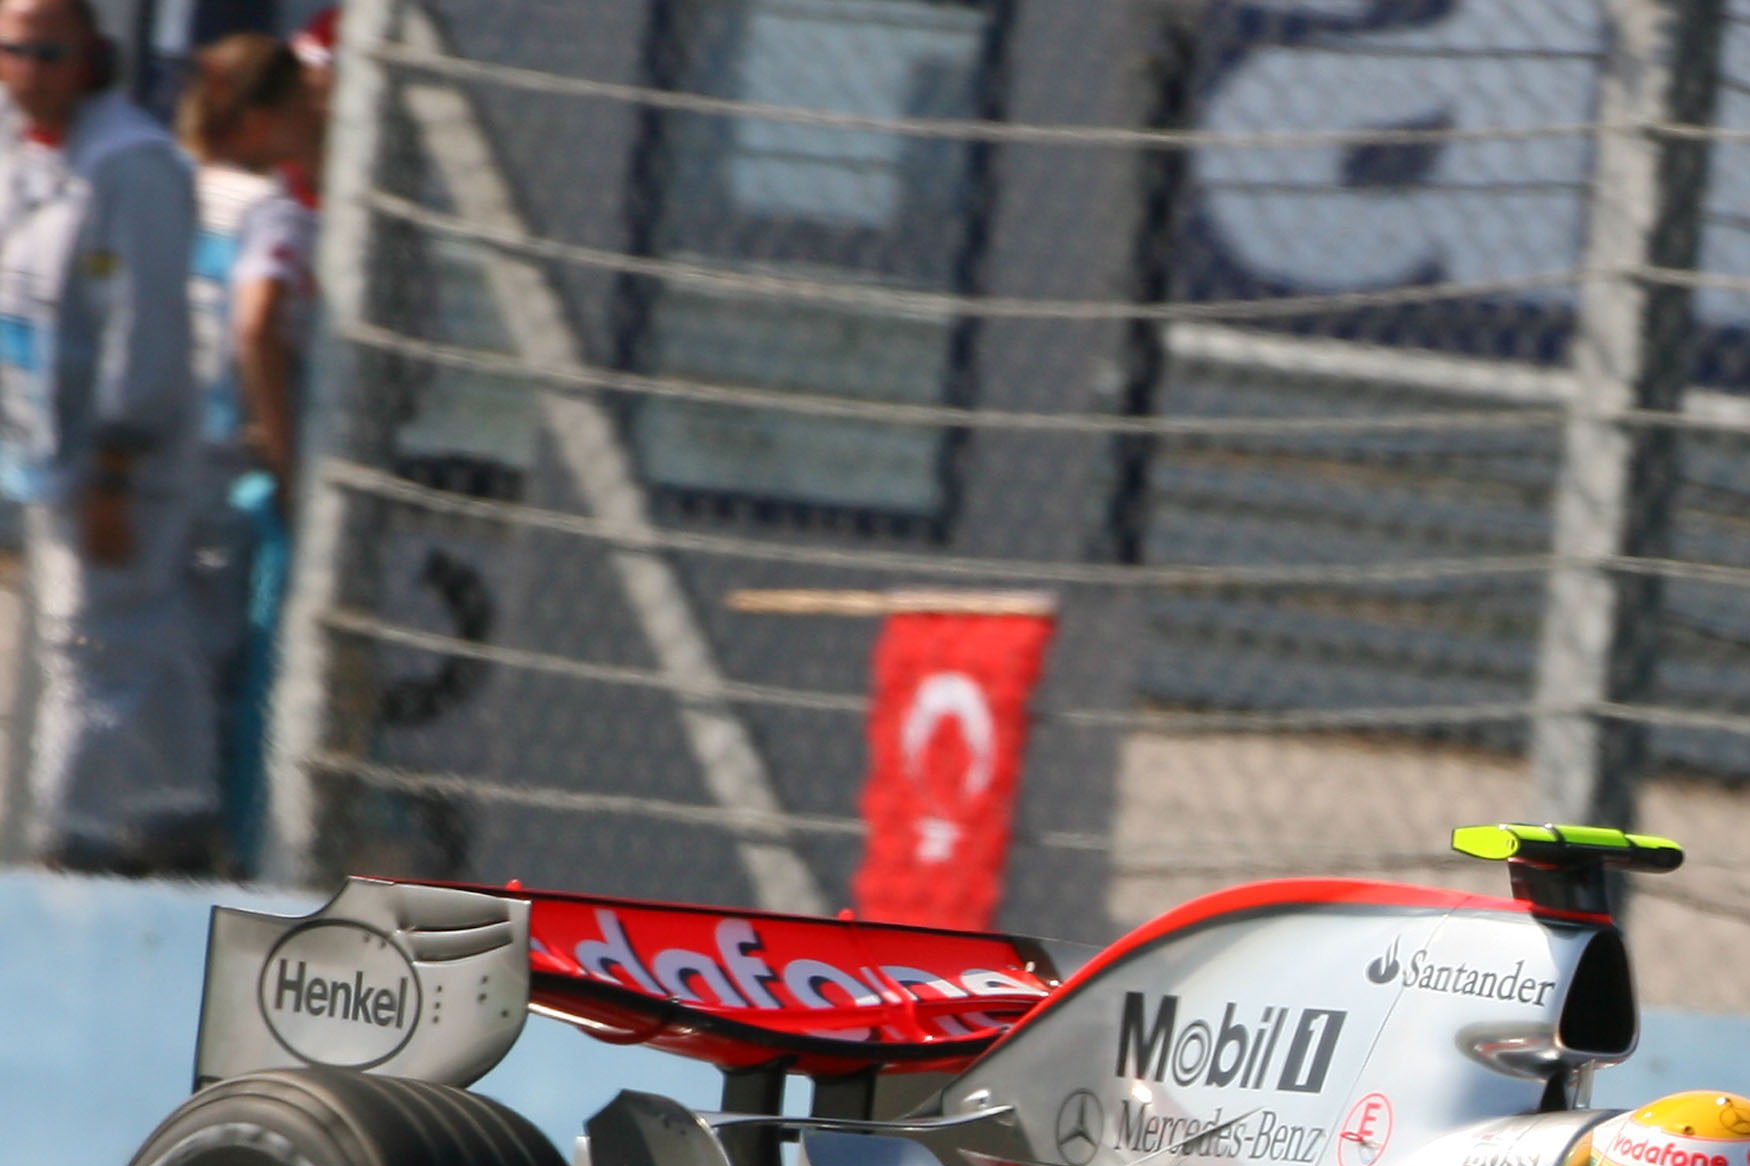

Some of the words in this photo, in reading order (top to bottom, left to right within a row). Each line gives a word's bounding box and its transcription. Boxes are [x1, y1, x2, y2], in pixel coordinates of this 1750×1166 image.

[274, 958, 408, 1029] Henkel
[1403, 948, 1555, 1009] Santander
[1115, 991, 1287, 1090] Mobil
[1114, 1100, 1325, 1164] Mercedes-Benz
